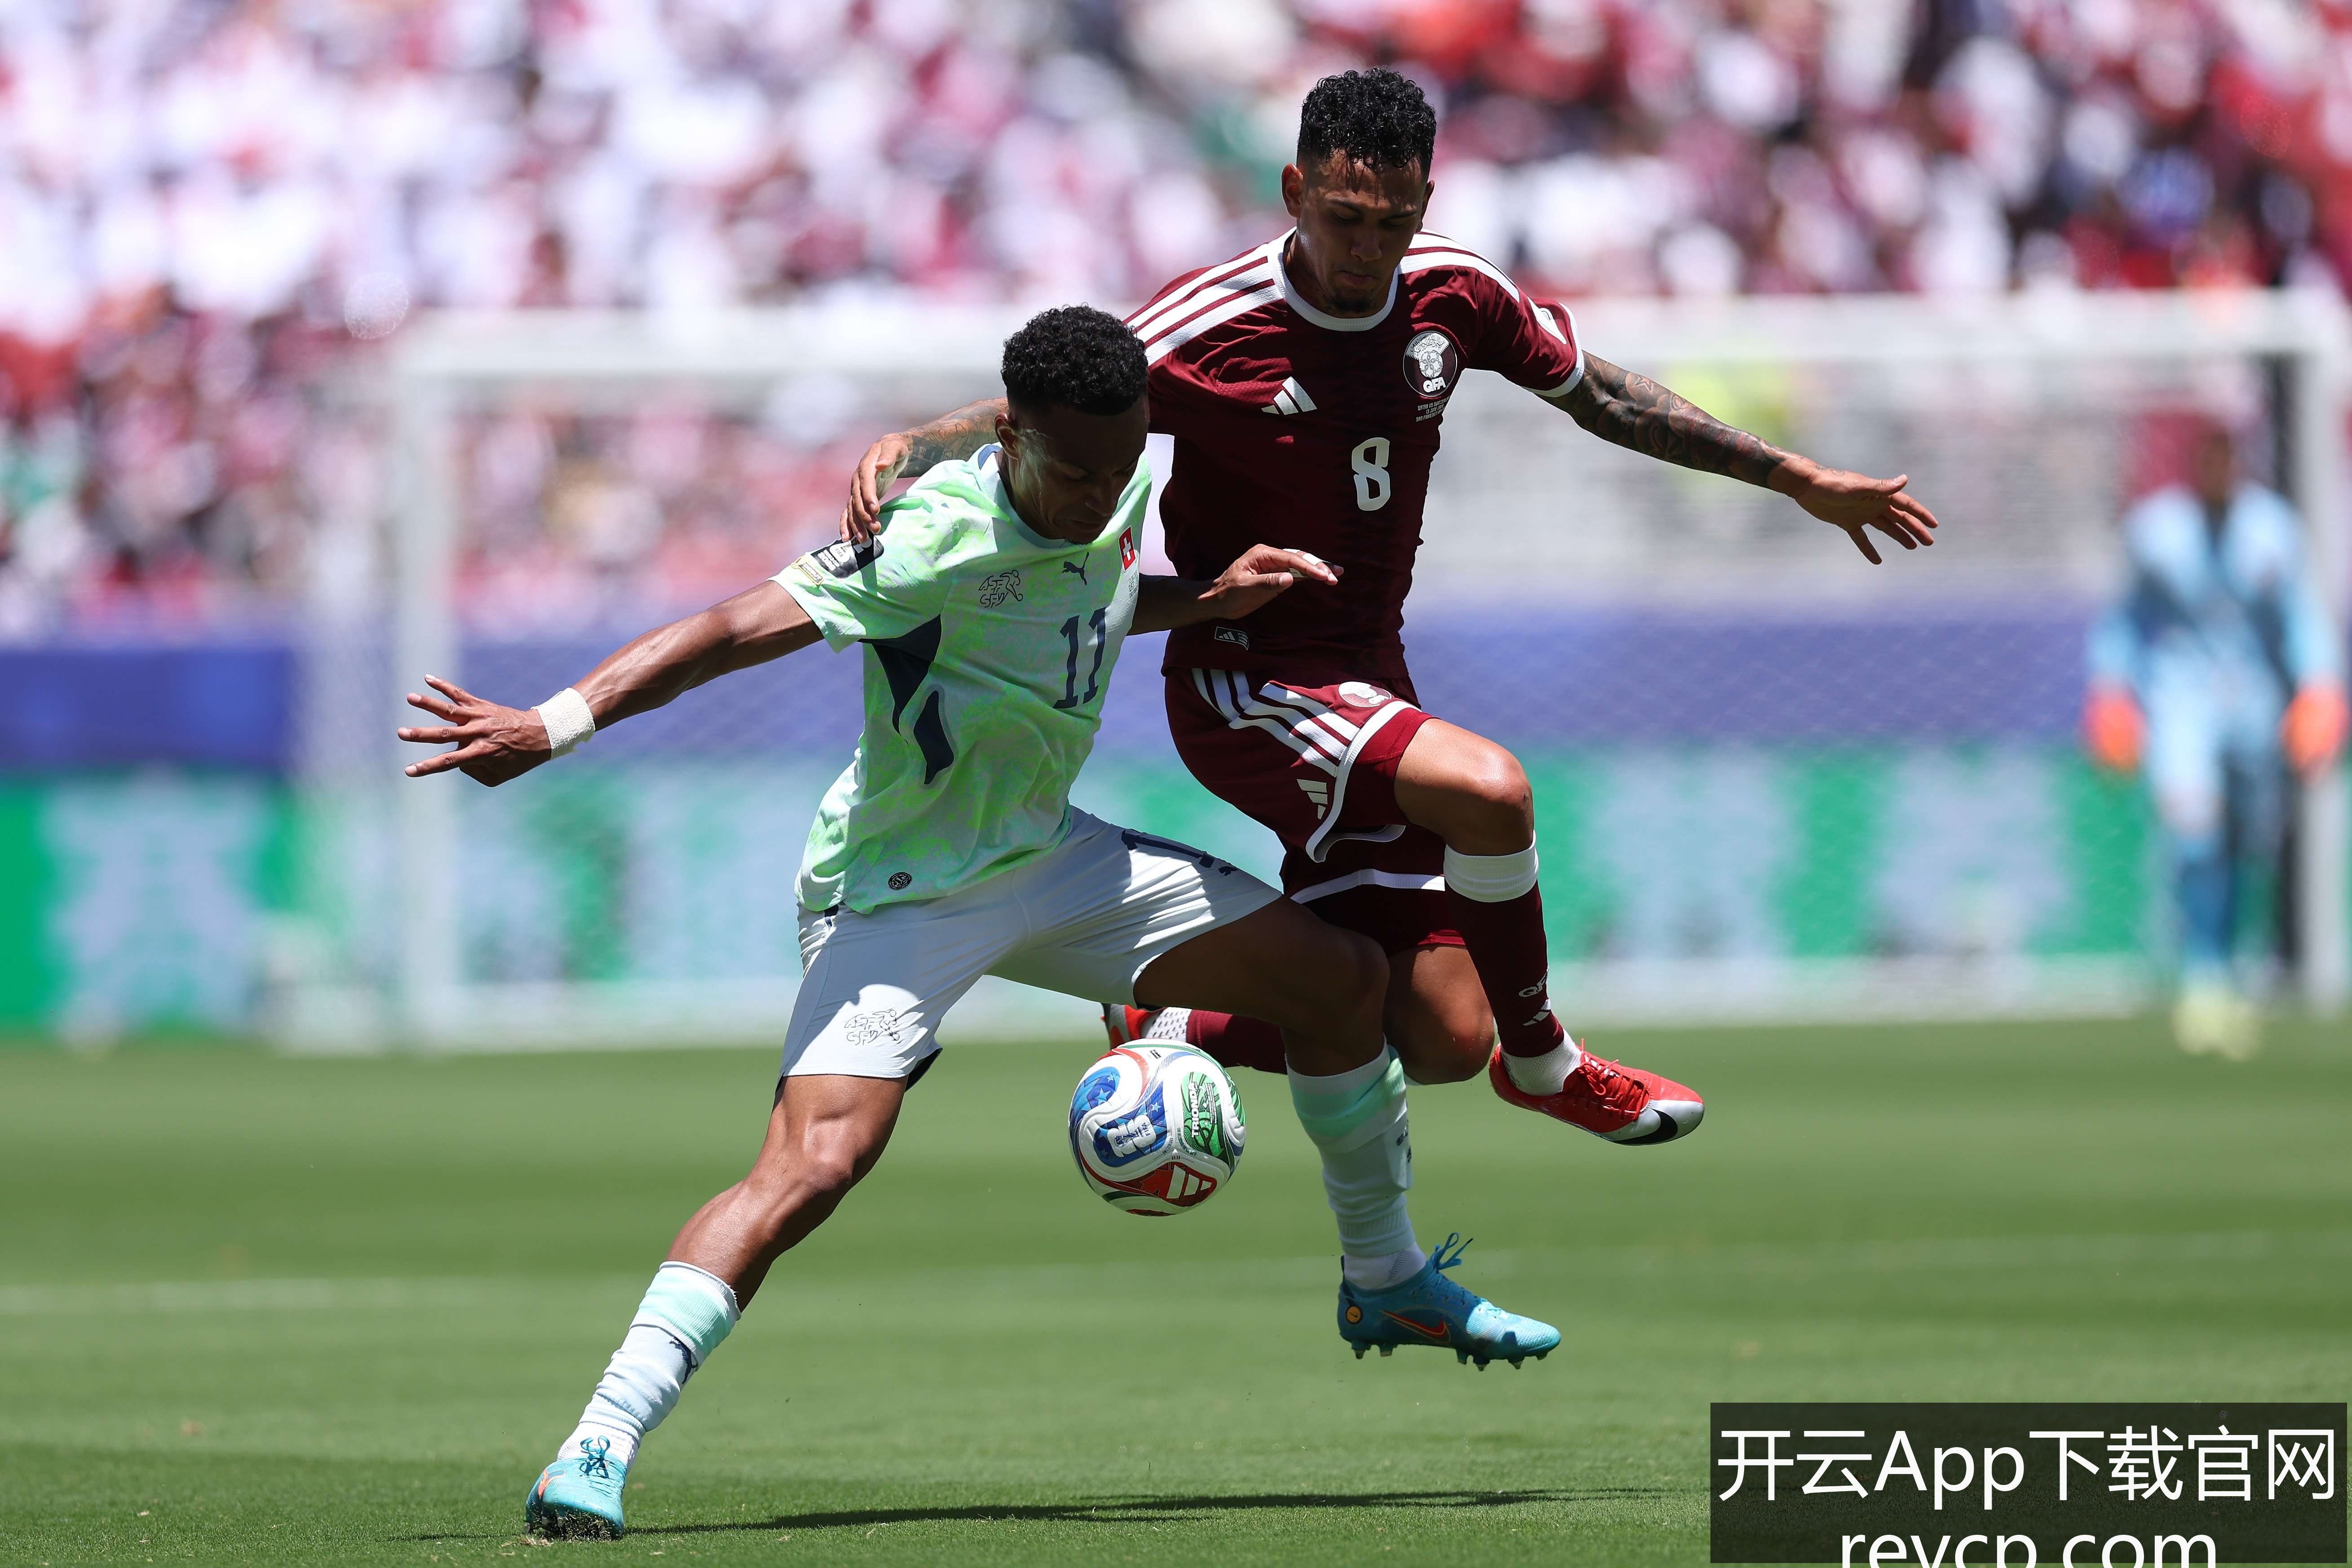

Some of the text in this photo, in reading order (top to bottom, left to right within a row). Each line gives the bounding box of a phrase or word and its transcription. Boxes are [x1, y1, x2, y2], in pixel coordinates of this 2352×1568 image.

[1423, 376, 1446, 393] QFA
[1351, 437, 1391, 511] 8
[835, 548, 843, 558] FIFA
[1053, 607, 1106, 709] 11
[1187, 1082, 1200, 1138] TRIONDA
[1142, 1122, 1151, 1136] FIFA
